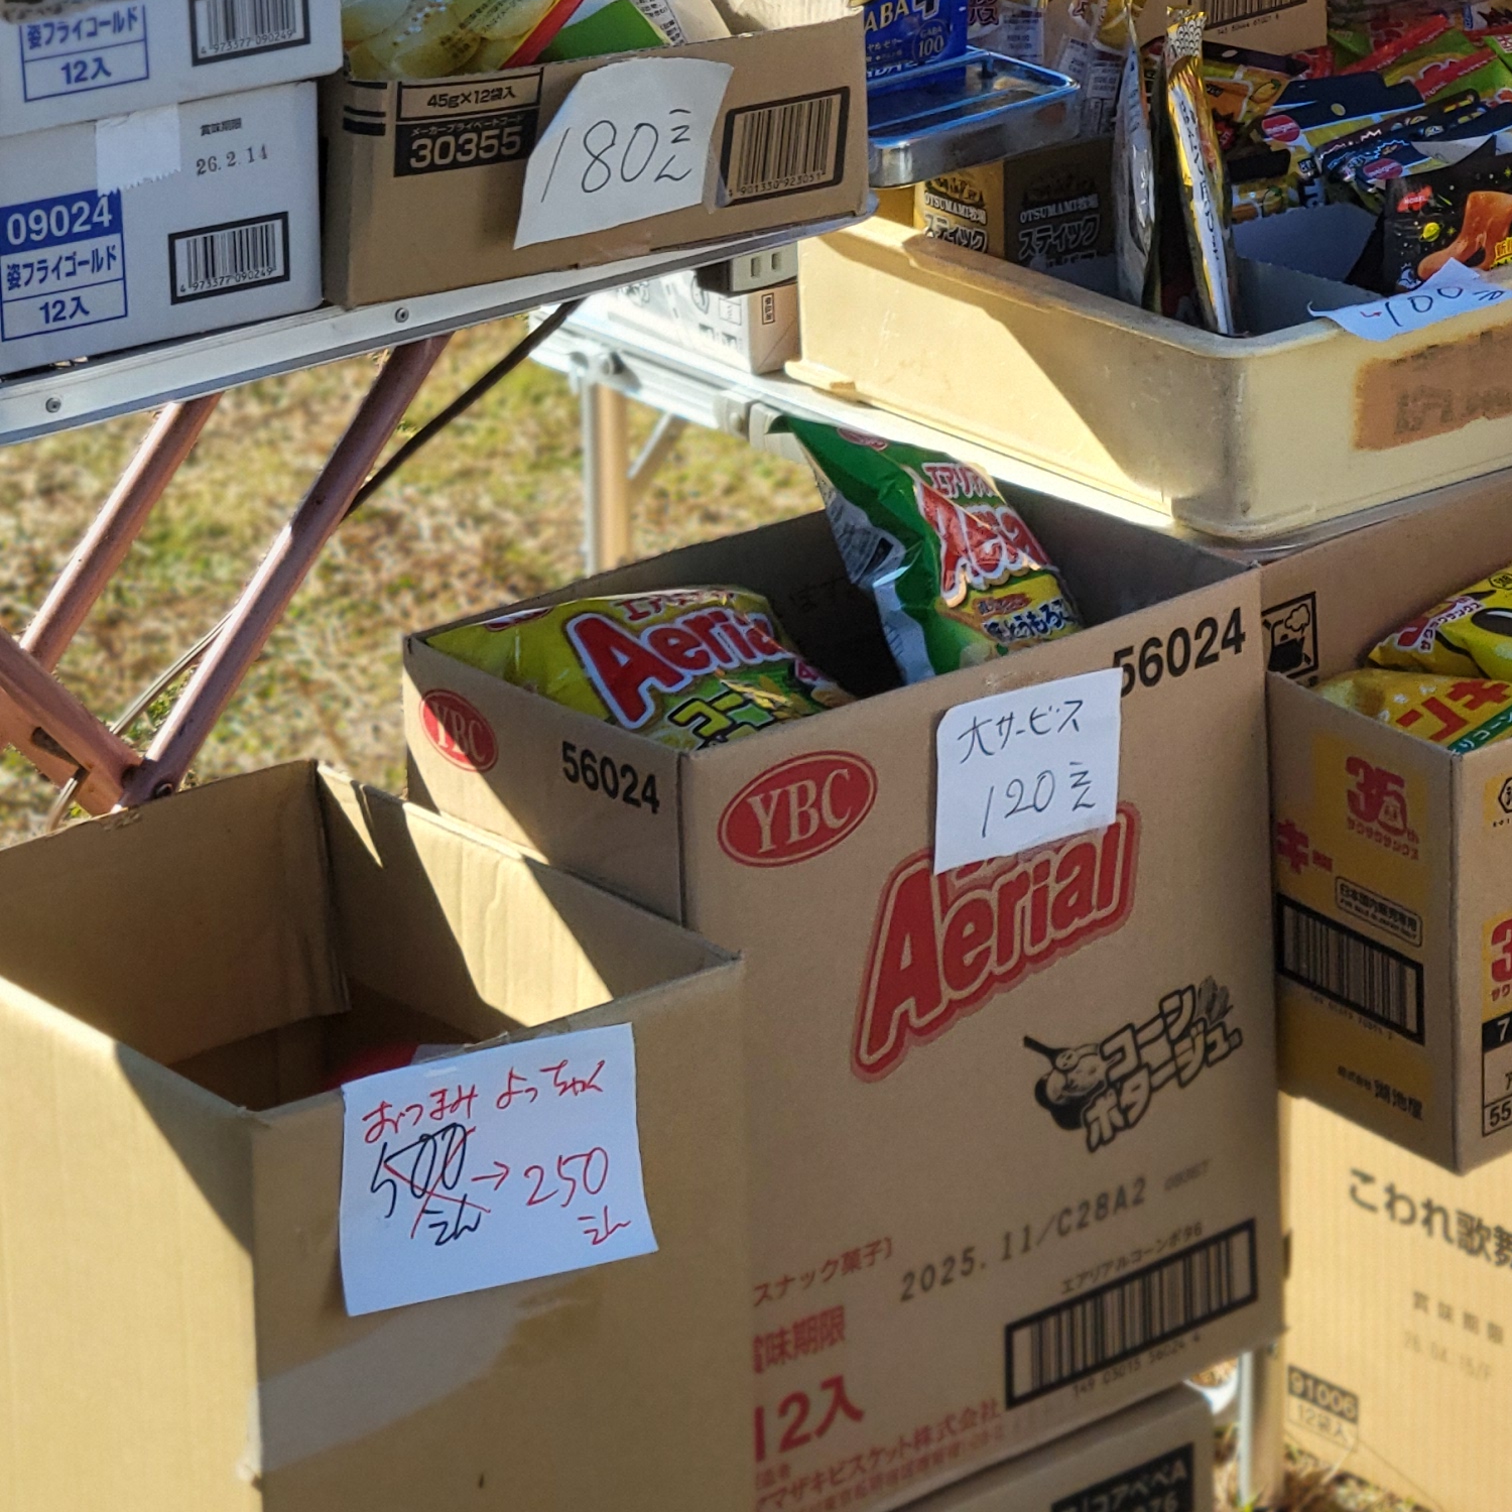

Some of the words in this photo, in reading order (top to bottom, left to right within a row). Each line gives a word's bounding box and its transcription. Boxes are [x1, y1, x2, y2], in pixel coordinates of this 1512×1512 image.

[60, 56, 112, 86] 12入
[409, 125, 523, 170] 30355
[6, 194, 113, 246] 09024
[6, 244, 118, 291] 姿フライゴールド
[39, 298, 90, 325] 12入
[566, 605, 795, 730] Aeria
[1111, 605, 1248, 699] 56024
[432, 700, 488, 763] YBC
[957, 699, 1086, 766] 大サービス
[561, 740, 662, 815] 56024
[746, 767, 851, 854] YBC
[856, 812, 1134, 1074] Aerial
[1100, 983, 1197, 1084] コーン
[361, 1083, 479, 1145] おつまみ
[523, 1145, 610, 1209] 250
[753, 1375, 865, 1463] 12入
